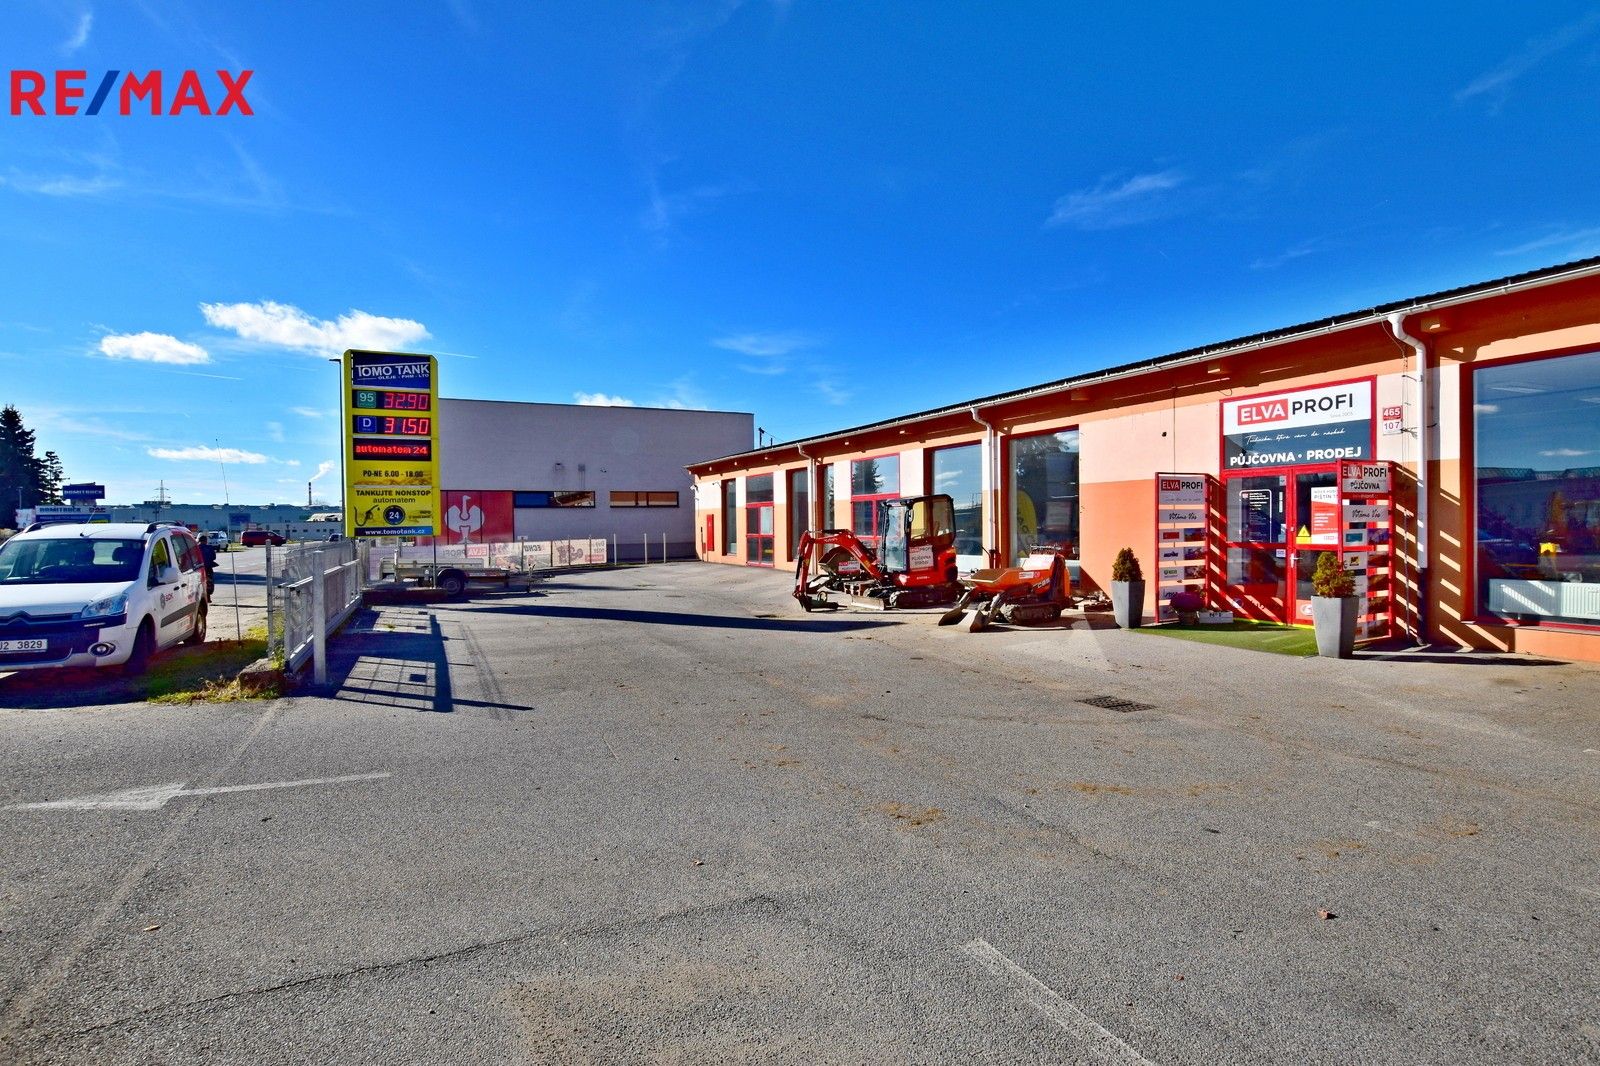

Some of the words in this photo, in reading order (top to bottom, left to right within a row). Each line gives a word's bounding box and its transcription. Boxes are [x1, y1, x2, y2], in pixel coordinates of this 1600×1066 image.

[355, 365, 392, 377] TOMO
[395, 364, 430, 375] TANK
[359, 392, 374, 402] 95
[1240, 403, 1286, 422] ELVA
[1292, 393, 1354, 415] PROFI
[1383, 407, 1401, 417] 465
[363, 418, 372, 428] D
[1384, 421, 1400, 430] 107
[356, 445, 411, 454] automatem
[413, 446, 427, 454] 24
[1229, 451, 1296, 466] PŮJČOVNA
[1306, 446, 1362, 461] PRODEJ
[1342, 465, 1361, 477] ELVA
[1363, 467, 1387, 478] PROFI
[1162, 481, 1180, 489] ELVA
[1181, 481, 1203, 490] PROFI
[1350, 480, 1380, 490] PŮJČOVNA
[389, 511, 400, 519] 24
[17, 640, 43, 649] 3829
